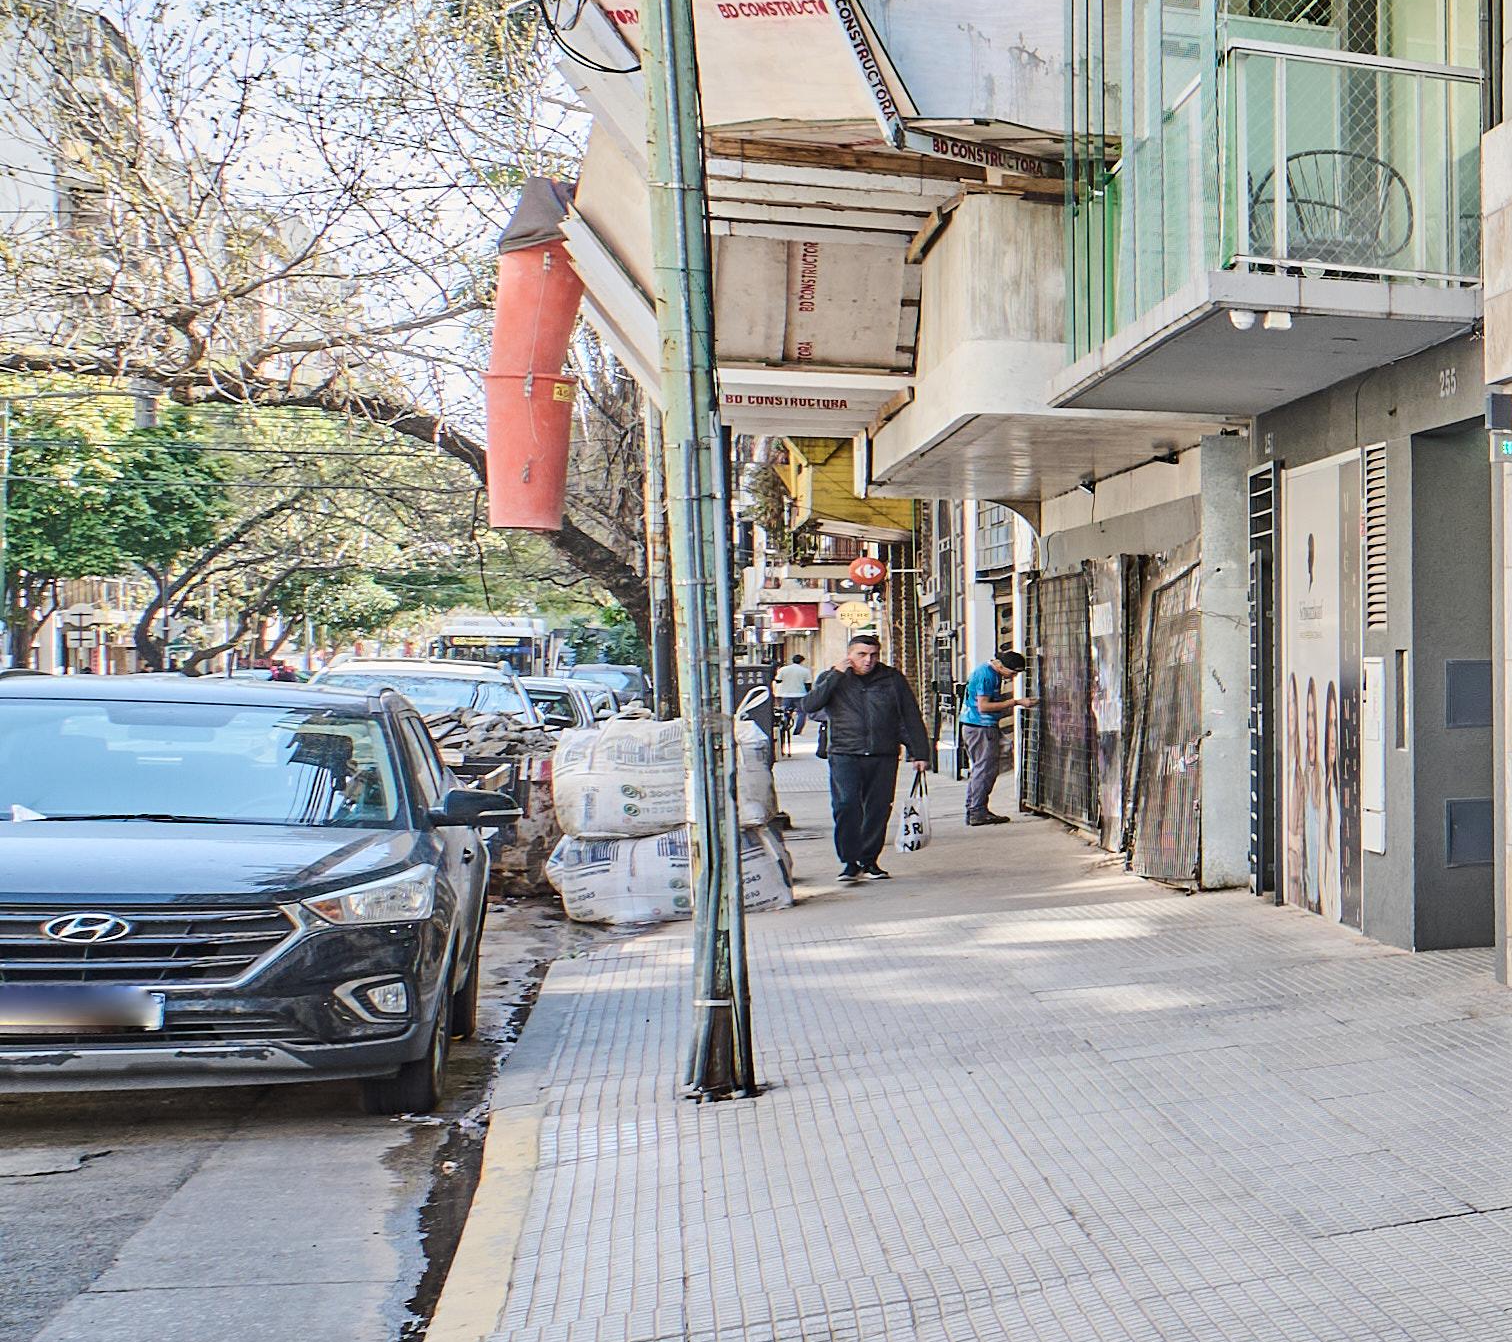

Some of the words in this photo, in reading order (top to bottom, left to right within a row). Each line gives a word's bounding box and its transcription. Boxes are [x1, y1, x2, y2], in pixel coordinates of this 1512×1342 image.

[717, 3, 739, 20] BD
[932, 138, 949, 155] BD
[951, 142, 1044, 176] CONSTRUCTORA
[1439, 367, 1458, 398] 255
[725, 394, 743, 404] BD
[747, 395, 848, 410] CONSTRUCTORA
